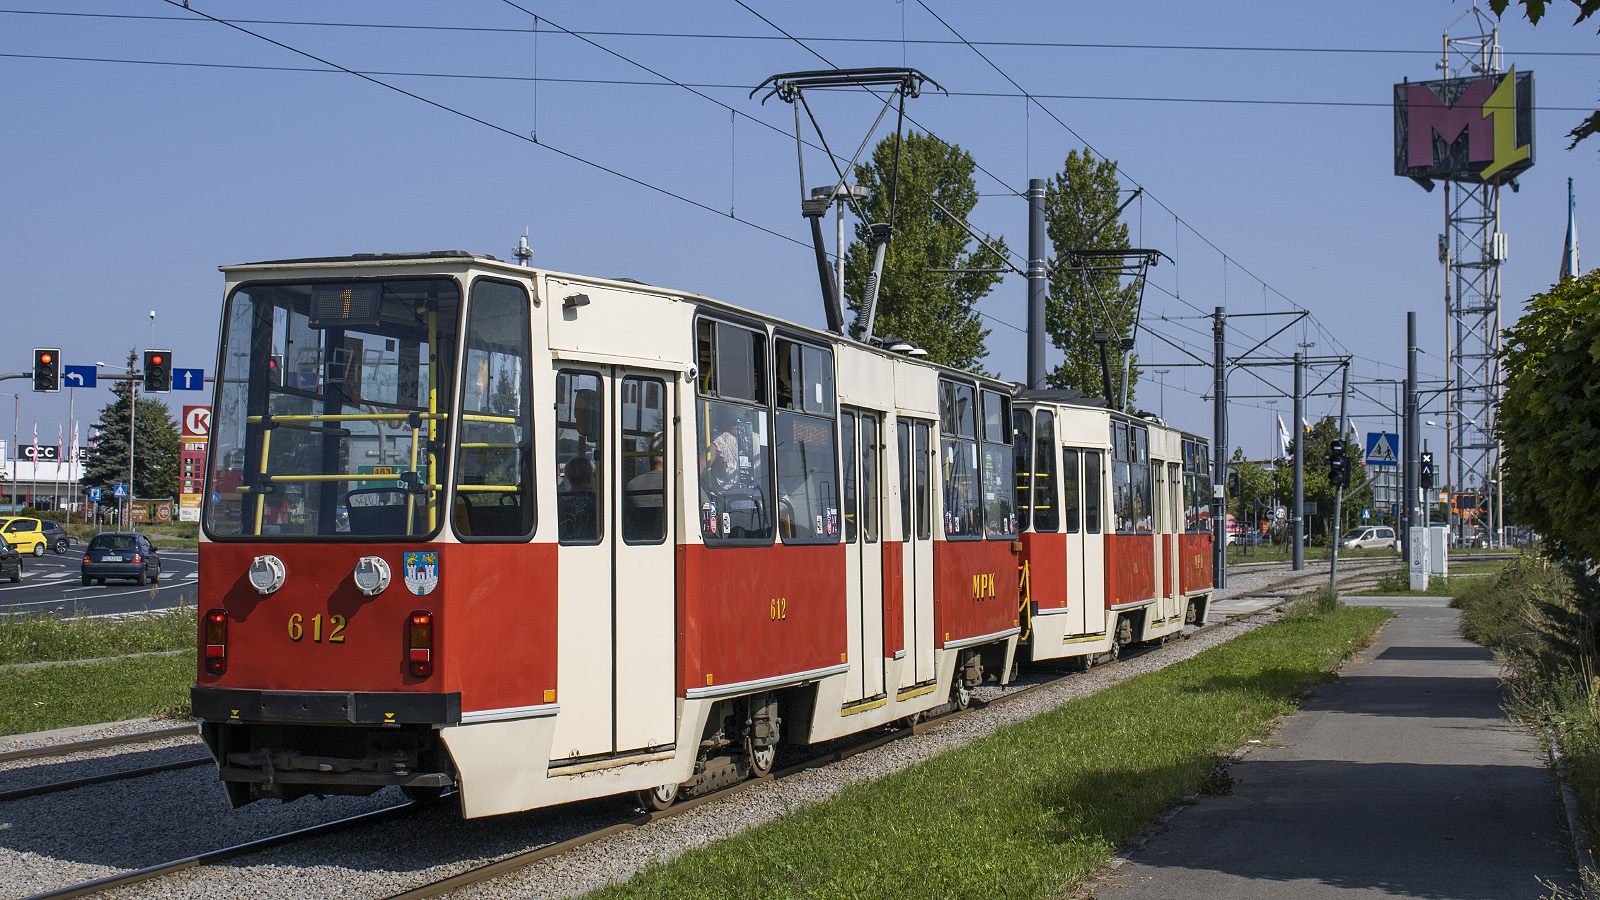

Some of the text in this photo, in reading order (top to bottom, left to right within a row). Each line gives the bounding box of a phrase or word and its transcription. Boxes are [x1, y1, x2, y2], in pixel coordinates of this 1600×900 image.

[1408, 63, 1530, 180] M1
[339, 289, 352, 319] 1
[194, 413, 209, 433] K
[972, 572, 996, 602] MPK
[770, 597, 787, 622] 612
[287, 612, 348, 645] 612
